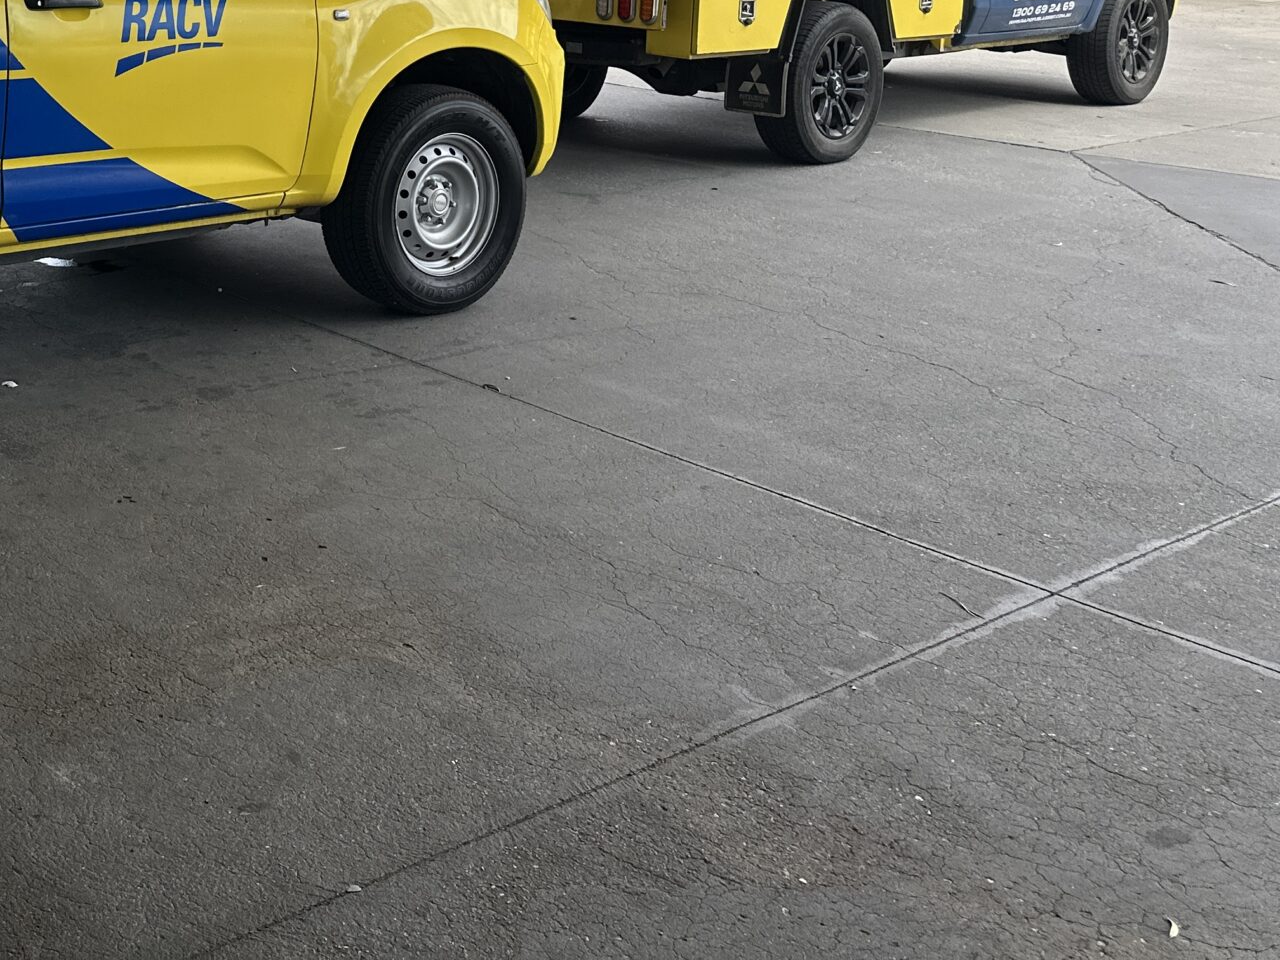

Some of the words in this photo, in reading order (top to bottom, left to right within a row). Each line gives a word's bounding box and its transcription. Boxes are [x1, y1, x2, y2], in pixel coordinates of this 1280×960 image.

[1012, 5, 1034, 18] 1300
[1034, 3, 1048, 15] 69
[1048, 2, 1062, 14] 24
[1062, 1, 1076, 12] 69
